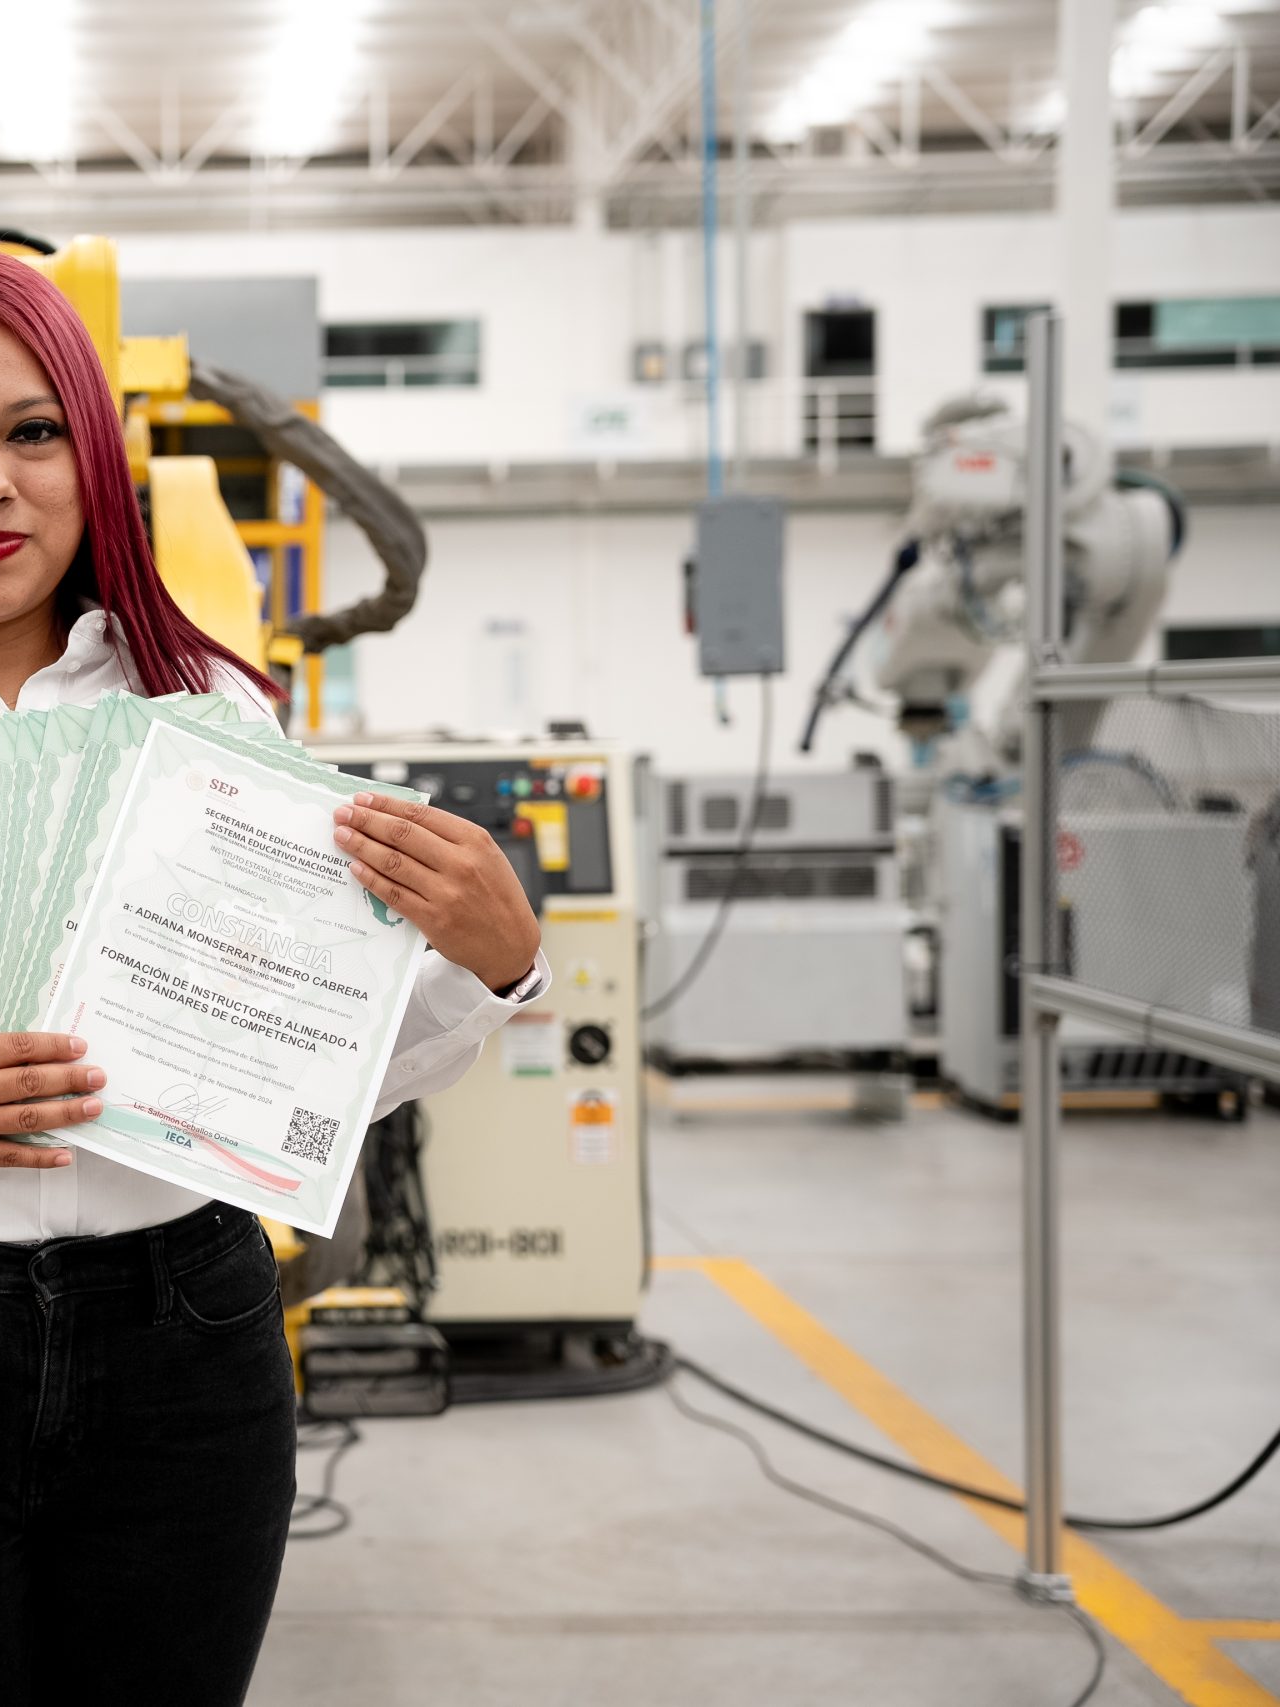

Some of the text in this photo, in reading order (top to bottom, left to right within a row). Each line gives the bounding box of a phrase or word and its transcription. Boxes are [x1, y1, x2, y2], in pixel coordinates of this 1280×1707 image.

[209, 778, 239, 798] SEP
[205, 808, 255, 834] SECRETARÍA
[256, 829, 268, 840] DE
[269, 835, 321, 859] EDUCACIÓN
[211, 823, 344, 878] SISTEMA EDUCATIVO NACIONAL
[211, 845, 334, 897] INSTITUTO ESTATAL DE CAPACITACIÓN
[222, 858, 316, 898] ORGANISMO DESCENTRALIZADO
[123, 903, 370, 1001] a: ADRIANA MONSERRAT ROMERO CABRERA
[167, 893, 332, 974] CONSTANCIA
[101, 946, 360, 1052] FORMACIÓN DE INSTRUCTORES ALINEADO A
[131, 974, 318, 1052] ESTÁNDARES DE COMPETENCIA
[136, 1011, 144, 1019] 20
[134, 1102, 148, 1112] Lic.
[148, 1108, 180, 1126] Salomón
[181, 1120, 213, 1138] Ceballos
[214, 1133, 239, 1146] Ochoa
[258, 1096, 273, 1105] 2024
[166, 1131, 194, 1148] IECA
